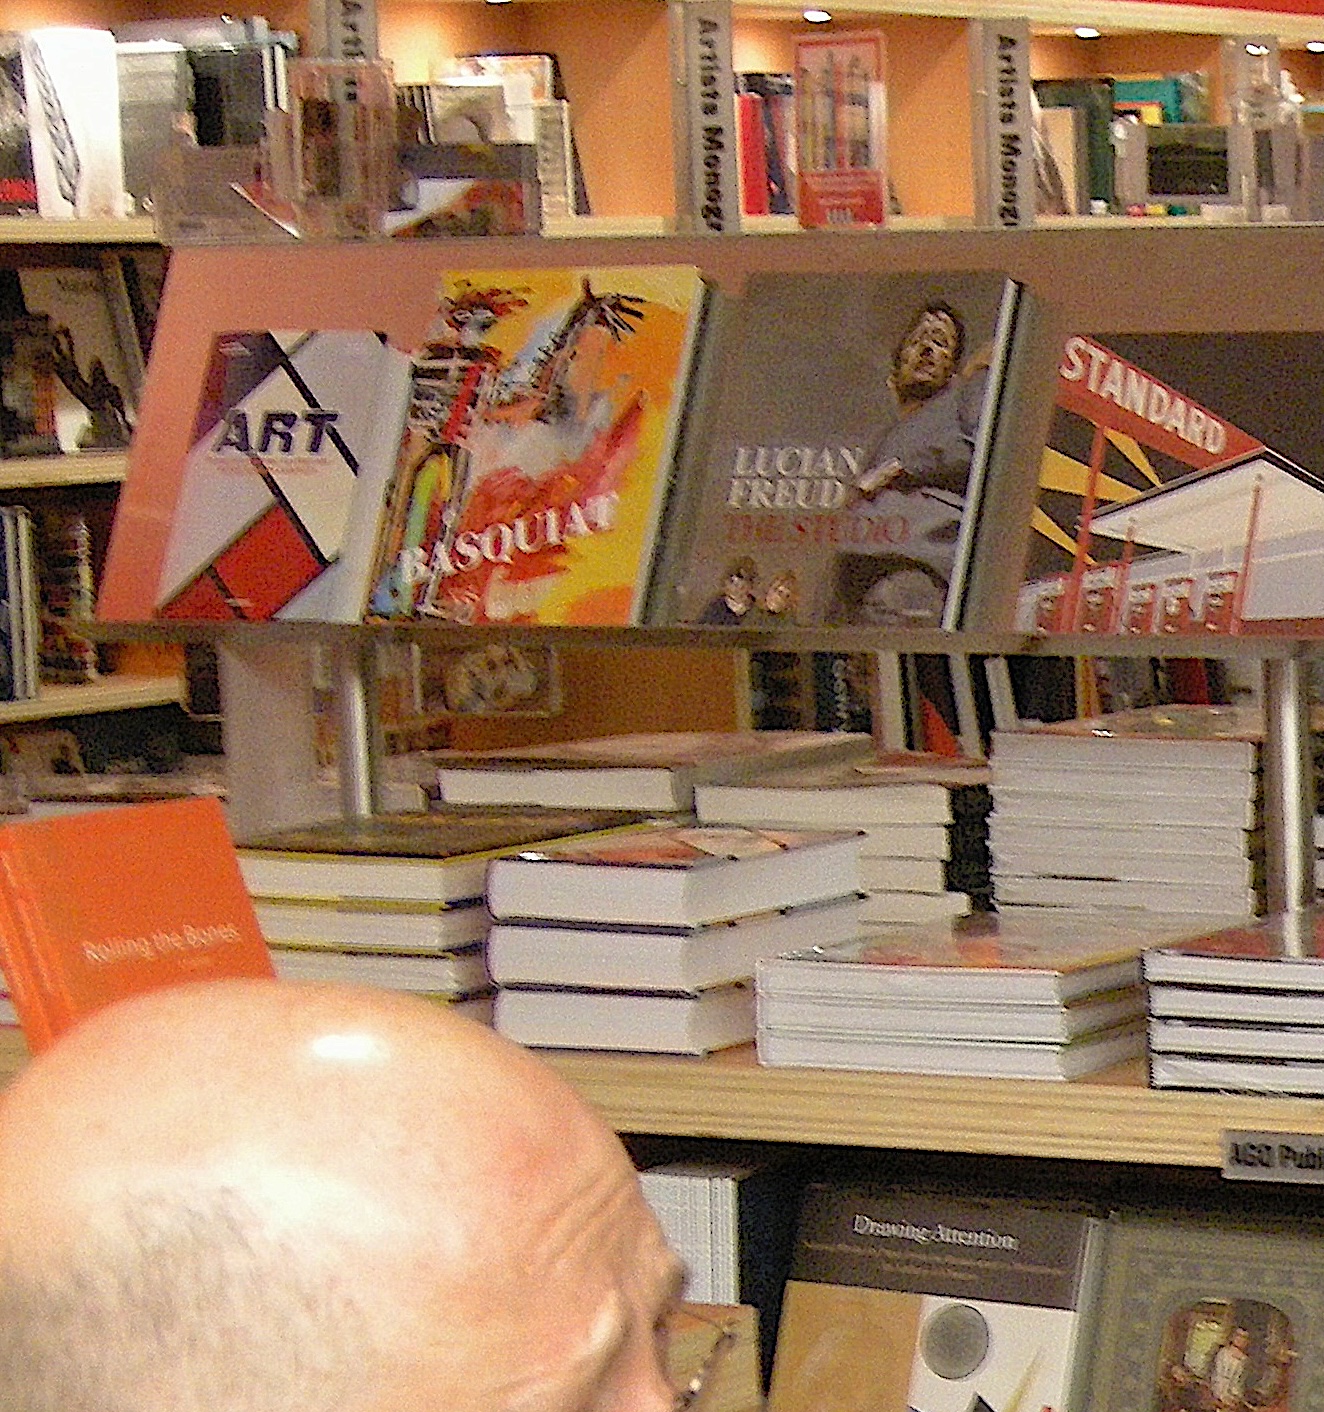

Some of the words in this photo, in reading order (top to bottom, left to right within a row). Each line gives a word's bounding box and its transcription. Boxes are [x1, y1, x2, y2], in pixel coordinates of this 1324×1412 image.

[1059, 336, 1227, 455] STANDARD
[211, 410, 339, 453] ART
[735, 447, 865, 477] LUCIAN
[729, 477, 847, 509] FREUD
[399, 491, 620, 585] BASQUIAT
[83, 939, 154, 963] Rolling
[152, 930, 184, 952] the
[184, 923, 242, 949] Bones
[853, 1214, 931, 1245] Drawing
[932, 1223, 1020, 1251] Attention
